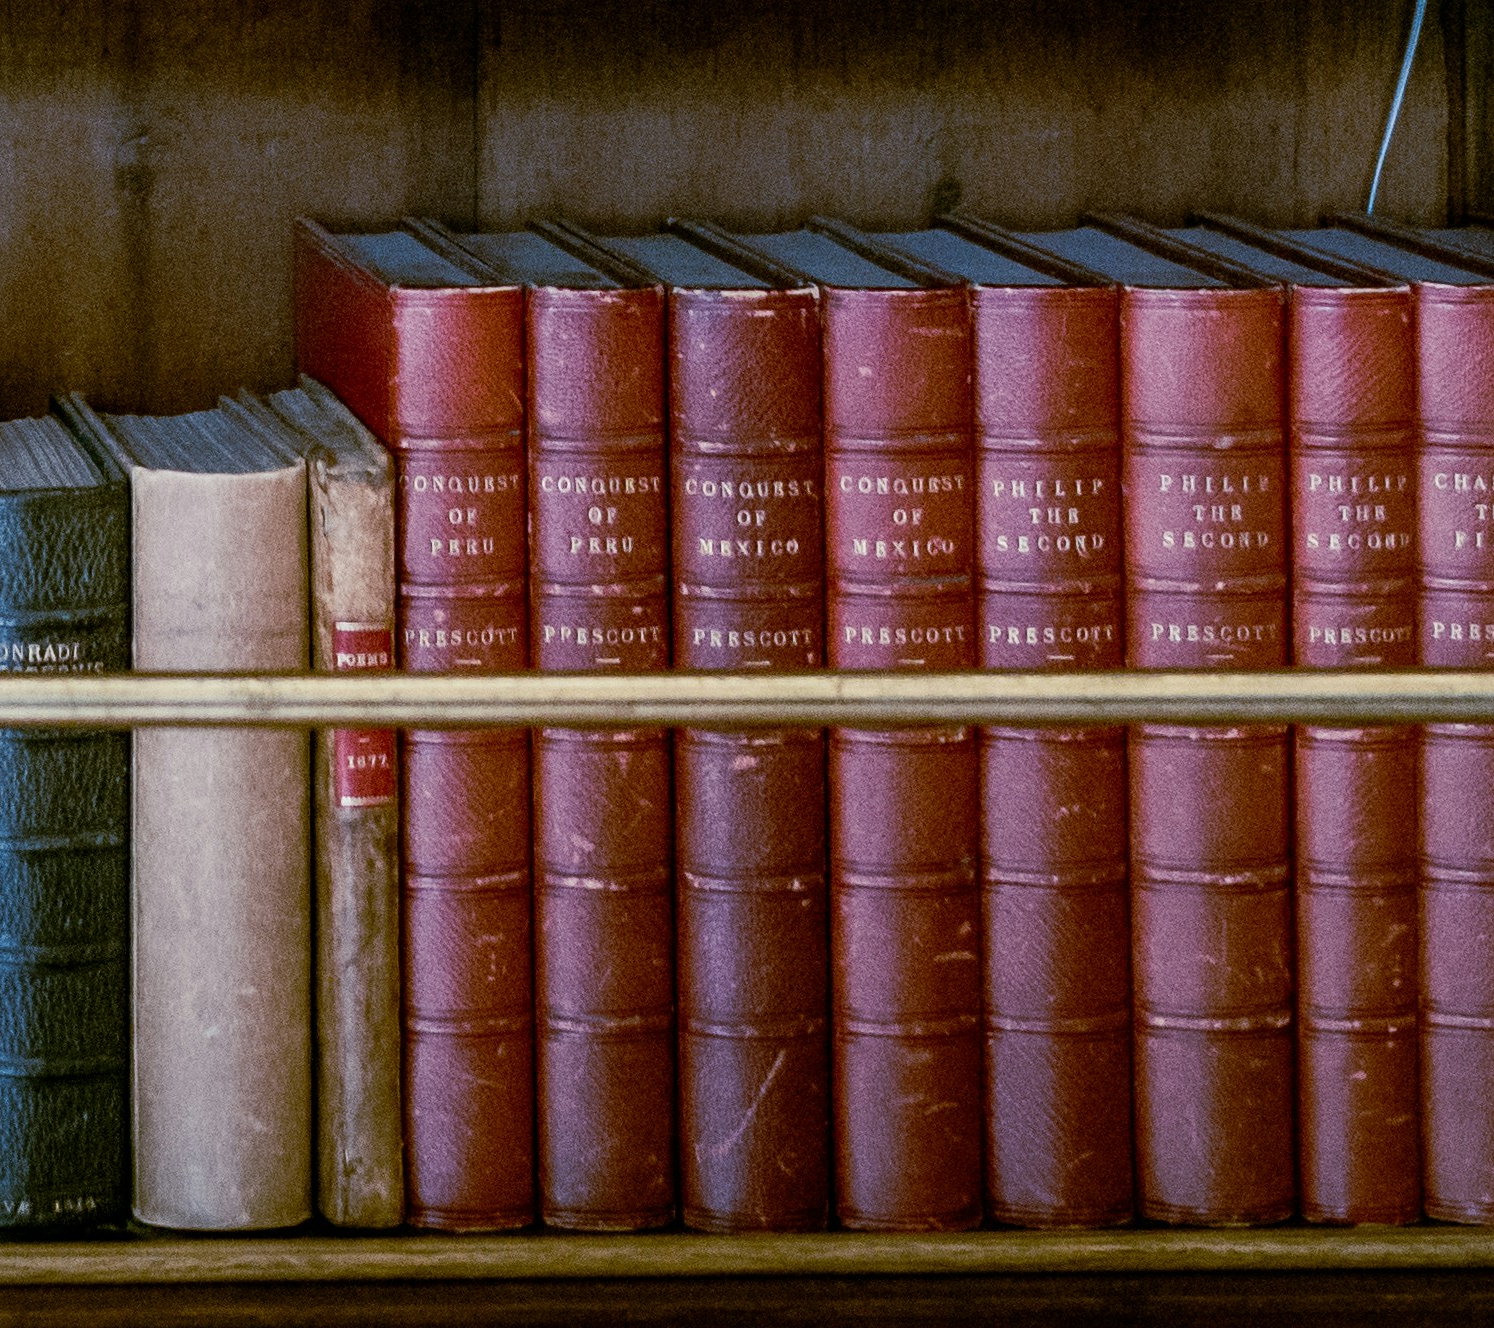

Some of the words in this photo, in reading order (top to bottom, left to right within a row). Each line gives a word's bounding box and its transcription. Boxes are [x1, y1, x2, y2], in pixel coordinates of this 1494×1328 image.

[399, 474, 520, 495] CONQUEST
[542, 474, 662, 495] CONQUEST
[686, 477, 815, 499] CONQUEST
[839, 475, 966, 494] CONQUEST
[993, 477, 1104, 499] PHILIP
[1160, 473, 1270, 494] PHILIP
[1309, 473, 1409, 494] PHILIP
[449, 506, 478, 526] OF
[589, 506, 618, 526] OF
[737, 506, 767, 527] OF
[892, 506, 923, 526] OF
[1029, 506, 1080, 526] THE
[1193, 502, 1244, 523] THE
[1338, 501, 1387, 522] THE
[429, 537, 496, 557] PERU
[571, 536, 634, 556] PERU
[699, 536, 800, 557] MEXICO
[852, 536, 955, 557] MEXICO
[996, 532, 1104, 552] SECOND
[1162, 529, 1269, 549] SECOND
[1306, 530, 1411, 551] SECOND
[405, 627, 519, 646] PRESCOTT
[544, 625, 662, 645] PRESCOTT
[693, 626, 814, 646] PRESCOTT
[845, 625, 965, 645] PRESCOTT
[988, 624, 1114, 644] PRESCOTT
[1150, 620, 1276, 641] PRESCOTT
[1309, 624, 1412, 645] PRESCOTT
[336, 652, 388, 668] POEMS
